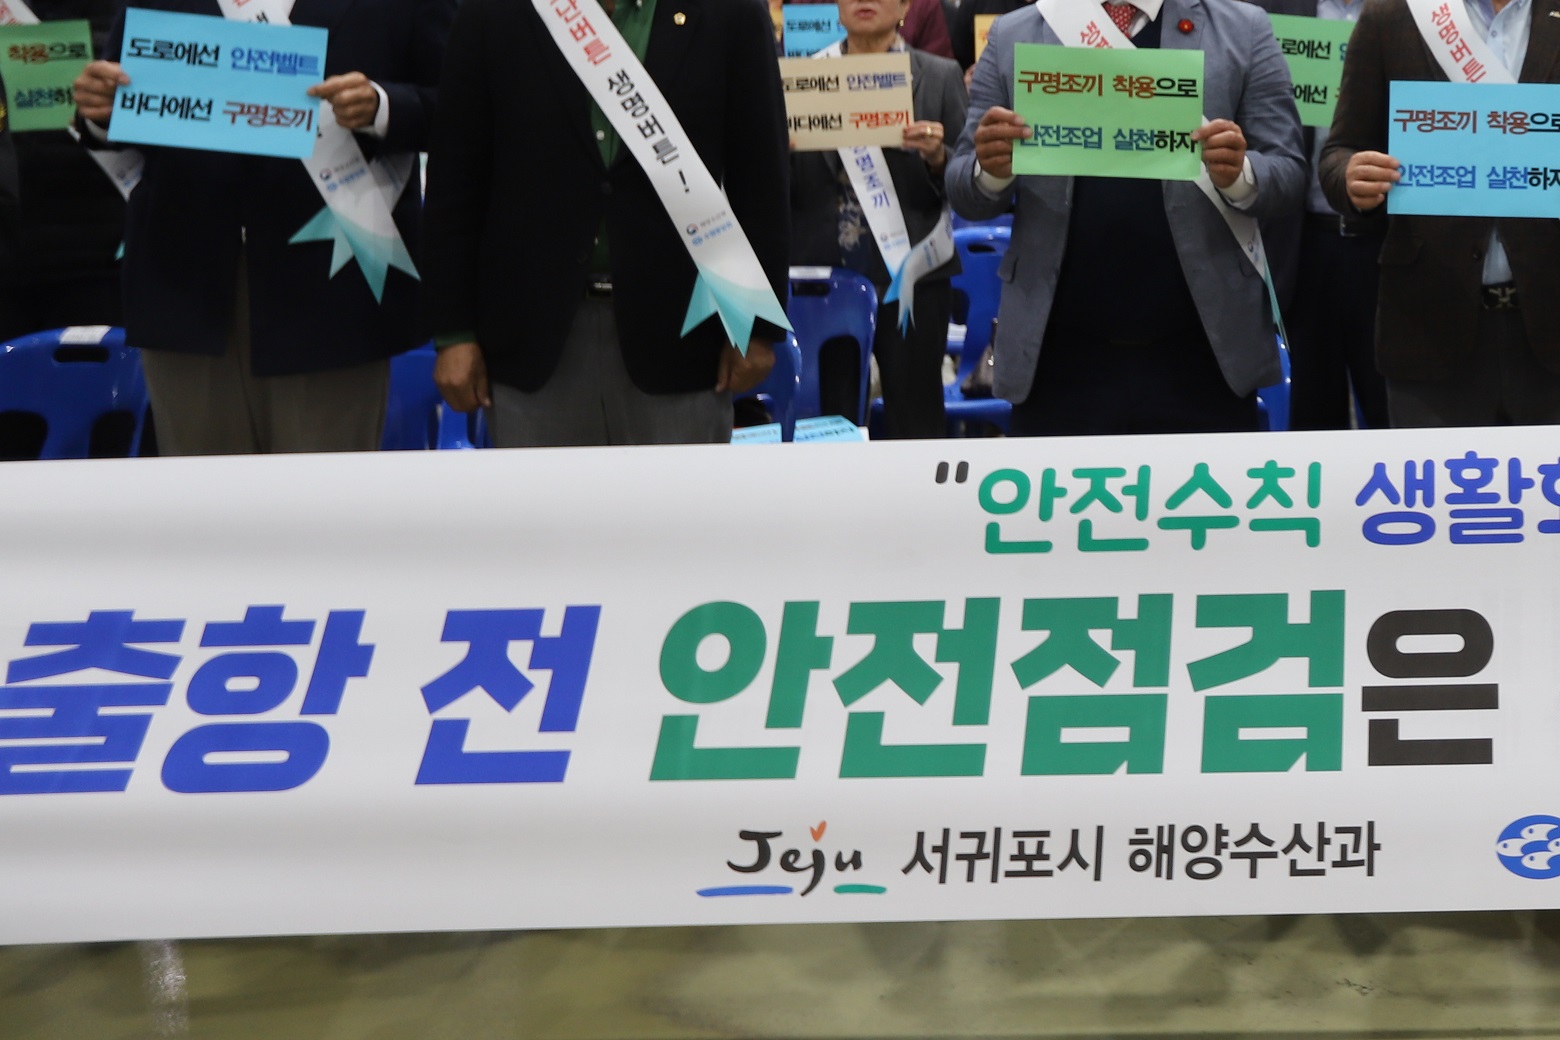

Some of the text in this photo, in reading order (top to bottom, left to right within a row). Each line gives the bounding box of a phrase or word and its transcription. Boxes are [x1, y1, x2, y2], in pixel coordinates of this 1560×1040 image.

[126, 37, 320, 76] 도로에선 안전벨트
[1276, 38, 1331, 60] 로에선
[1430, 2, 1487, 83] 생명버튼
[782, 72, 907, 92] 도로에선 안전벨트
[1018, 70, 1198, 98] 구명조끼 착용으로
[15, 87, 73, 109] 실천하
[120, 91, 314, 132] 바다에선 구명조끼
[849, 110, 909, 129] 구명조끼
[1393, 110, 1477, 134] 구명조끼
[1113, 128, 1198, 153] 실천하자
[1398, 164, 1476, 189] 안전조업
[934, 460, 1321, 554] "안전수칙
[0, 605, 375, 794] 출항
[414, 605, 602, 785] 전
[649, 589, 1499, 782] 안전점검은
[727, 821, 862, 898] Jeju
[901, 820, 1382, 885] 서귀포시 해양수산과
